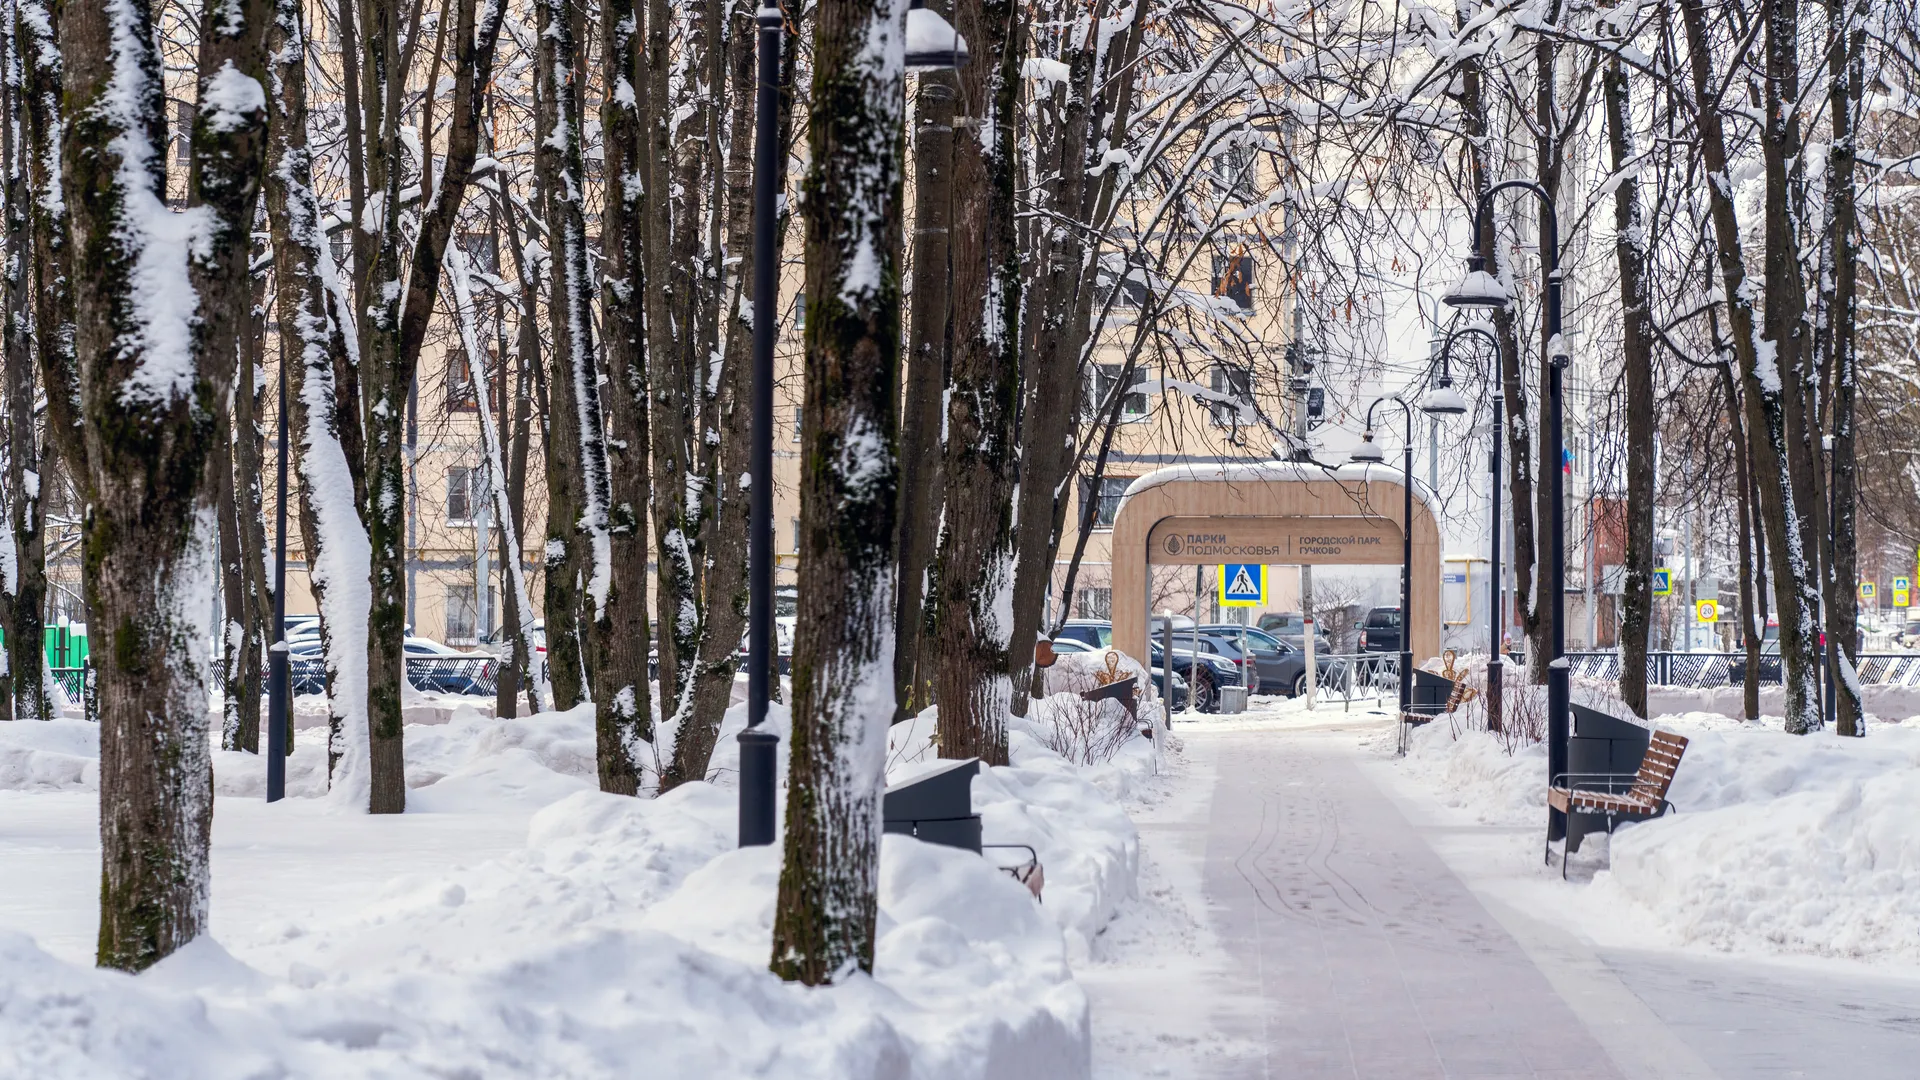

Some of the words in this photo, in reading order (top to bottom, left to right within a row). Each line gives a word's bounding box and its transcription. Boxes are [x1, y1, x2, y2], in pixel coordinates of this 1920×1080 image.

[1187, 534, 1226, 544] ПАРКИ
[1299, 535, 1356, 545] ГОРОДСКОЙ
[1357, 537, 1381, 545] ПАРК
[1187, 546, 1280, 555] ПОДМОСКОВЬЯ
[1299, 547, 1341, 555] ГУЧКОВО
[1703, 607, 1712, 615] 20
